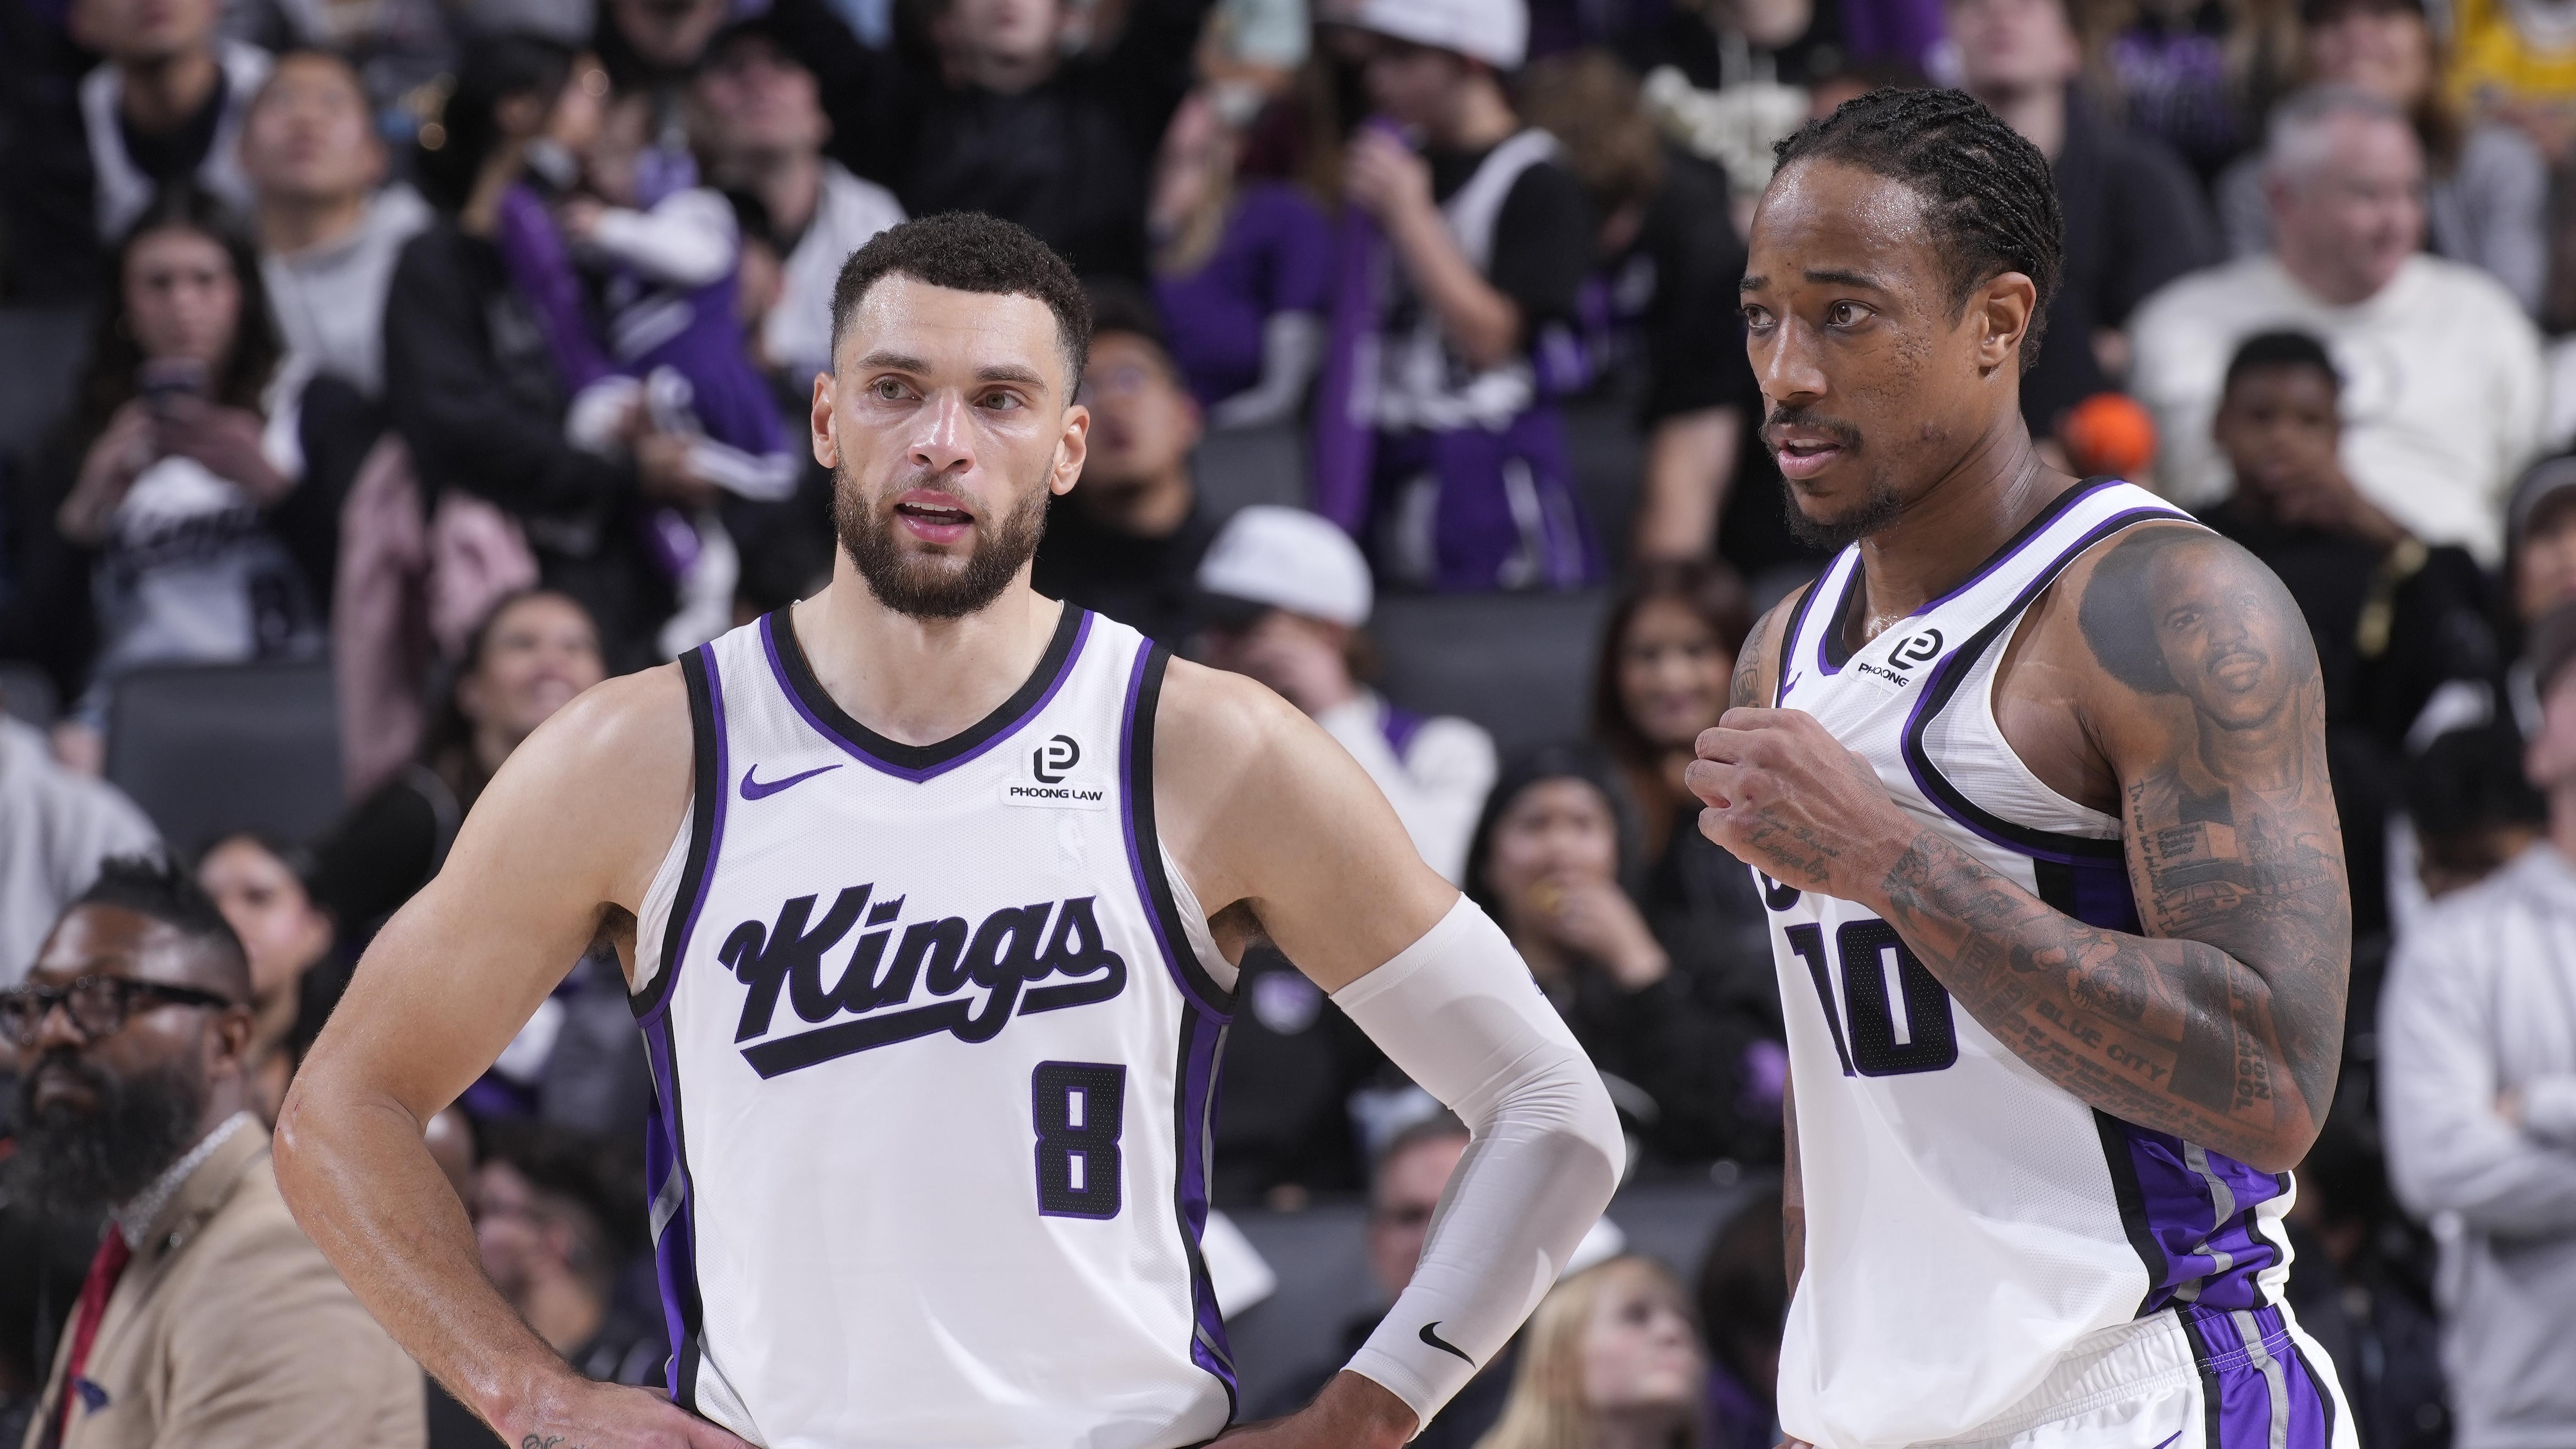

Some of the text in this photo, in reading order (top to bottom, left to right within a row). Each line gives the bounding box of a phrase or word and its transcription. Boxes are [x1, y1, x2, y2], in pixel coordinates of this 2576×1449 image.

[1858, 662, 1909, 687] PHOONG
[1010, 787, 1103, 800] PHOONG LAW
[717, 882, 1127, 1080] Kings
[1784, 918, 1959, 1078] 10
[2036, 999, 2103, 1049] BLUE
[2108, 1044, 2167, 1080] CITY
[1032, 1060, 1127, 1219] 8
